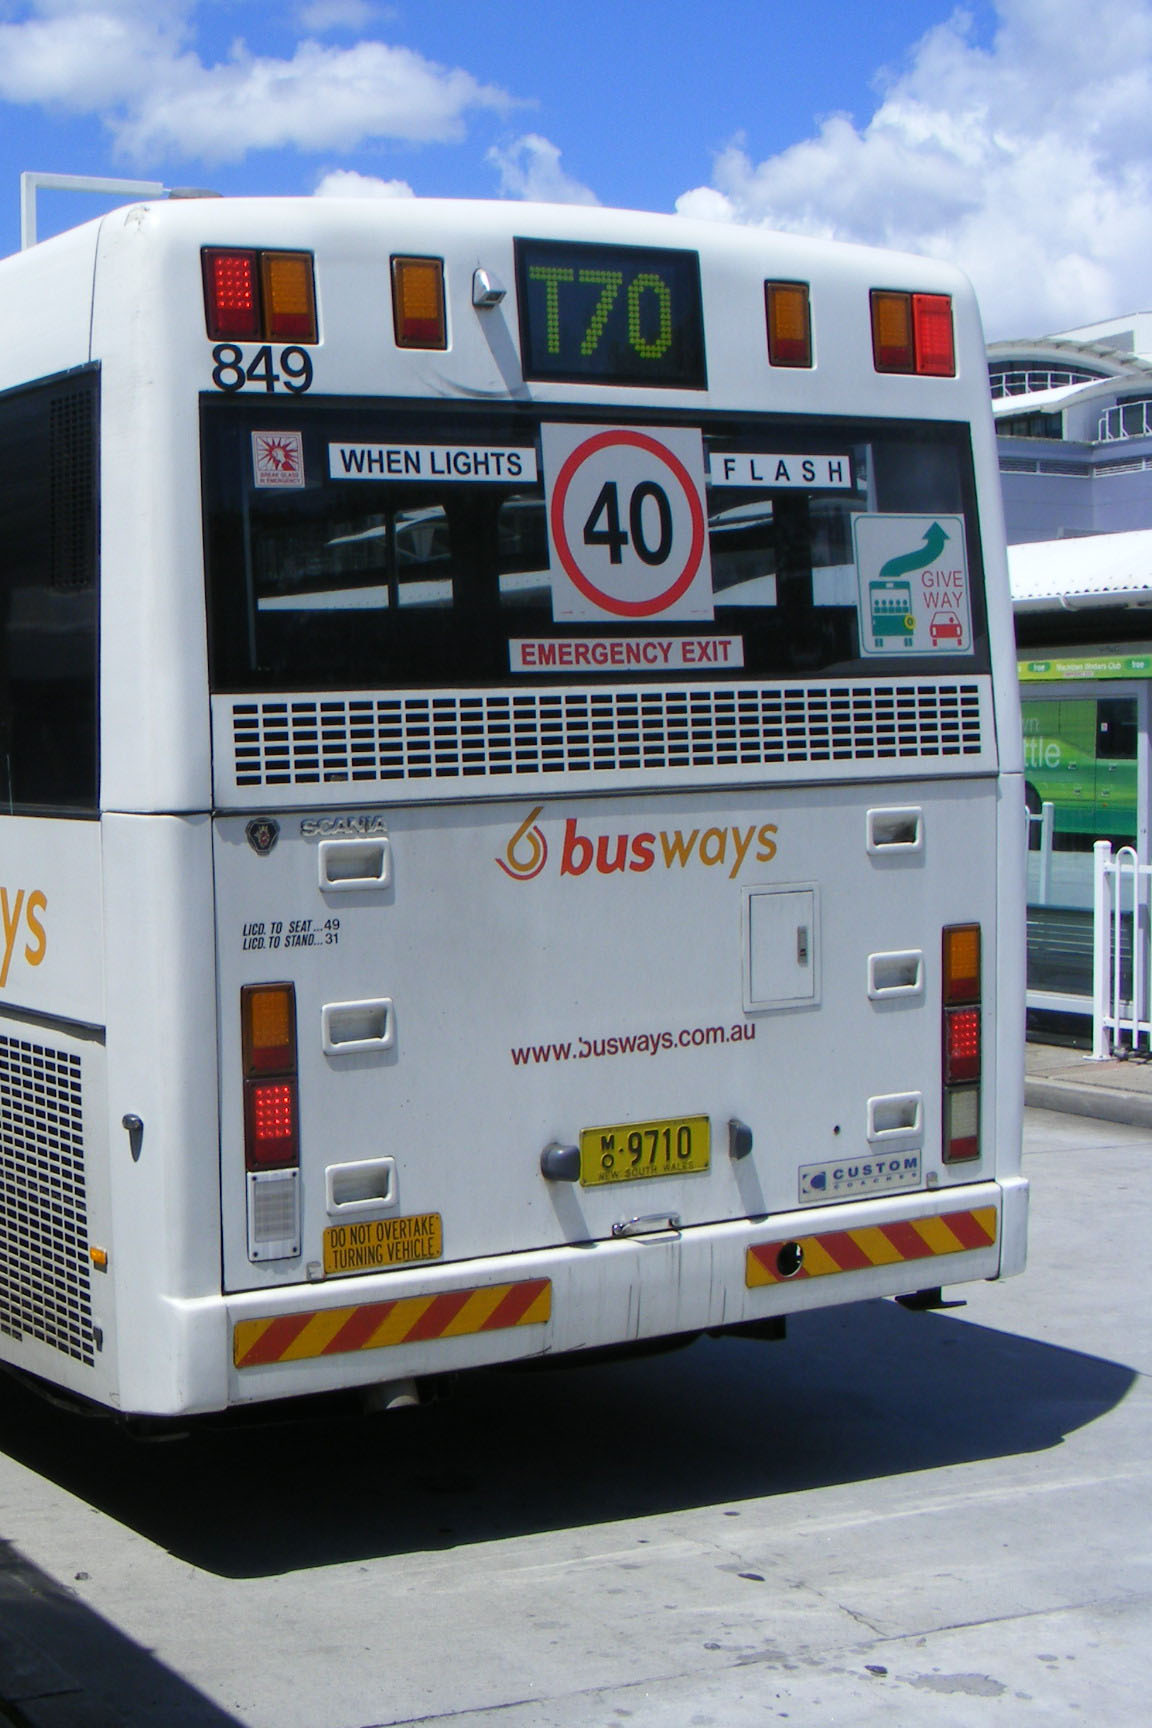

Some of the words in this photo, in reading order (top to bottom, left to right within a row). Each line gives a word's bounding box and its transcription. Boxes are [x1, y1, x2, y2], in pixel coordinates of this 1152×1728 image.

[530, 266, 673, 358] T70
[211, 344, 314, 394] 849
[340, 449, 422, 475] WHEN
[429, 451, 523, 476] LIGHTS
[723, 458, 844, 483] FLASH
[583, 481, 673, 566] 40
[921, 570, 964, 588] GIVE
[922, 591, 964, 609] WAY
[520, 642, 674, 666] EMERGENCY
[682, 640, 733, 664] EXIT
[300, 815, 389, 837] SCANIA
[560, 818, 779, 879] busways
[271, 922, 283, 934] TO
[269, 936, 280, 949] TO
[511, 1022, 757, 1066] www.busways.com.au
[624, 1167, 657, 1178] SOUTH
[663, 1161, 695, 1171] WALES
[833, 1157, 918, 1180] CUSTOM
[330, 1228, 346, 1249] DO
[350, 1224, 372, 1245] NOT
[376, 1215, 436, 1241] OVERTAKE
[332, 1244, 383, 1269] TURNING
[387, 1236, 435, 1262] VEHICLE
